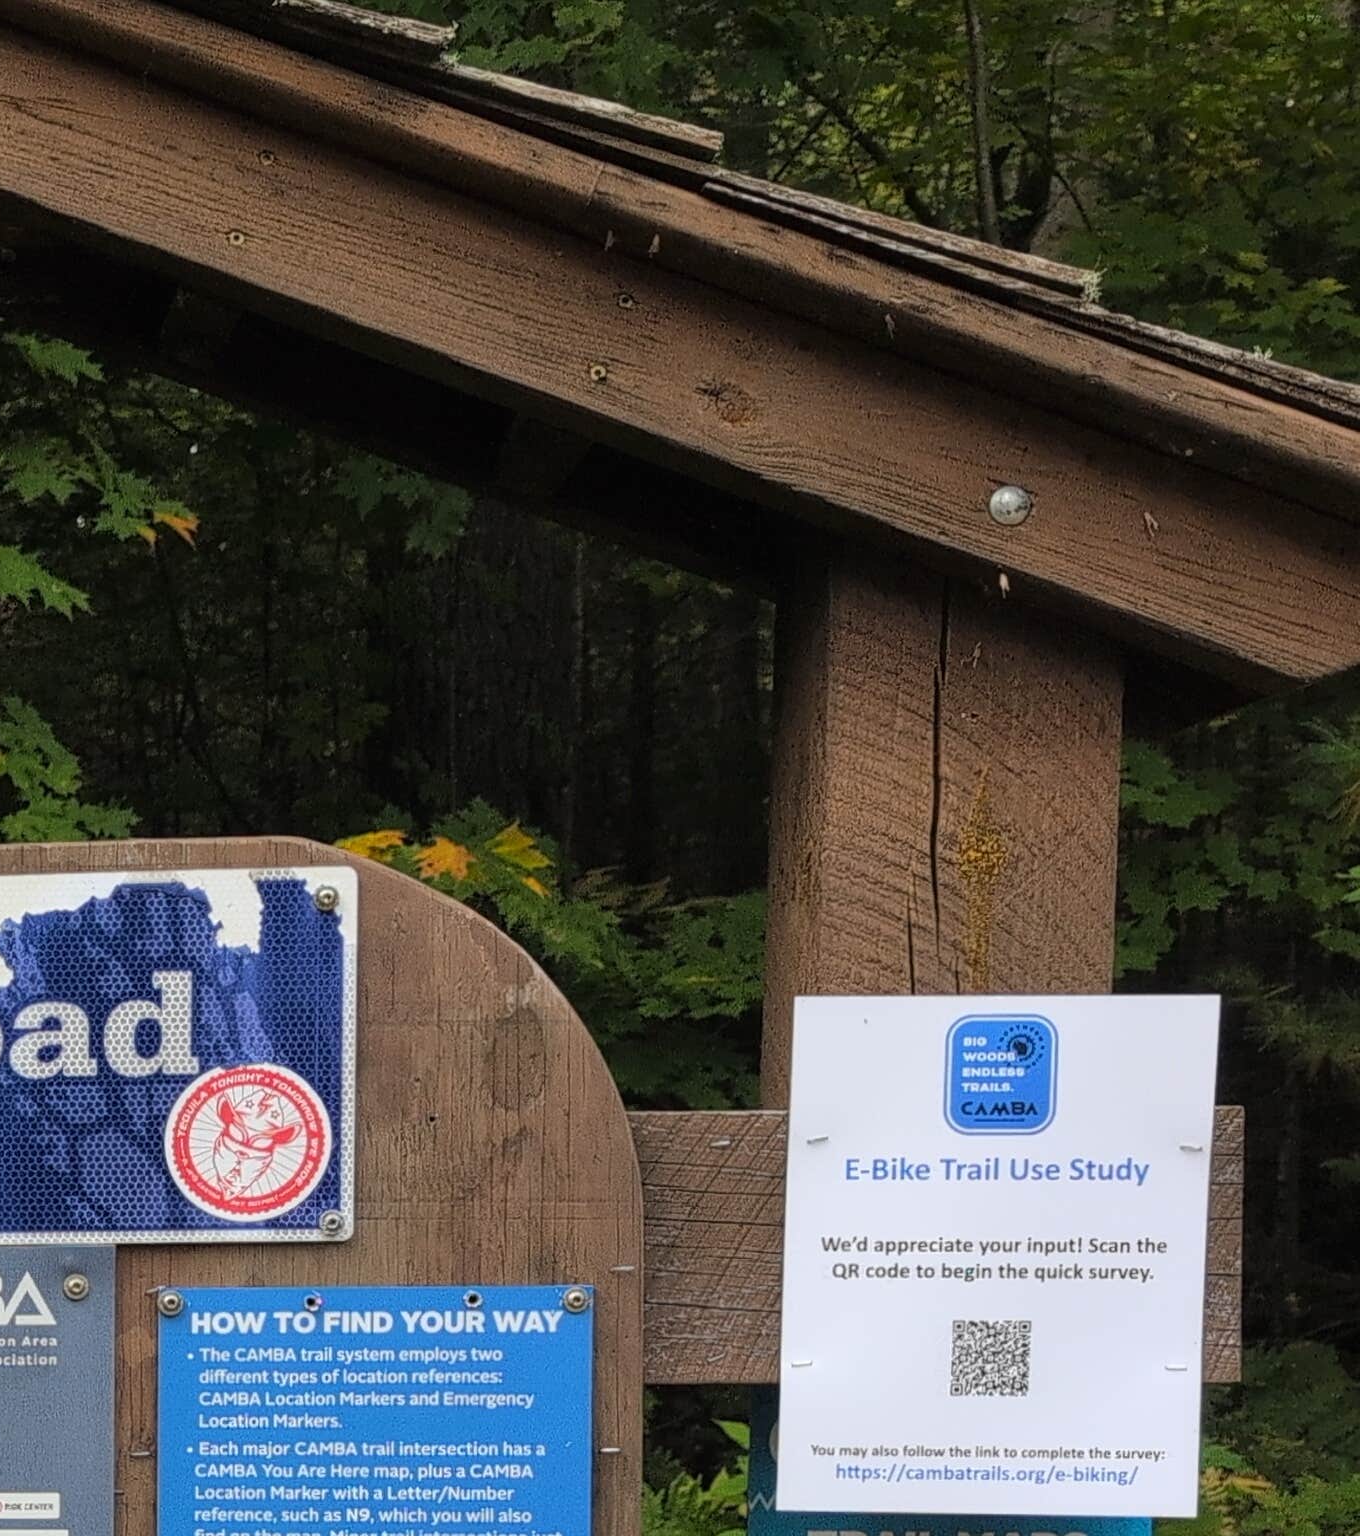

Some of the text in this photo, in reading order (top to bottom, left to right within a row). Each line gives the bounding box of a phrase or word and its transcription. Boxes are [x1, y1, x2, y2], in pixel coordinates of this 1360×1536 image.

[961, 1101, 1038, 1116] CAMBA
[846, 1158, 1149, 1186] E-Bike Trail Use Study
[875, 1237, 973, 1256] appreciate
[980, 1241, 1021, 1256] your
[1028, 1237, 1082, 1256] input!
[1089, 1238, 1130, 1253] Scan
[1137, 1237, 1167, 1253] the
[833, 1262, 1153, 1283] QR code to begin the quick survey.
[192, 1310, 563, 1334] HOW TO FIND YOUR WAY
[22, 1335, 57, 1346] Area
[200, 1346, 503, 1365] The CAMBA trail system employs two
[836, 1463, 1138, 1486] https://cambatrails.org/e-biking/
